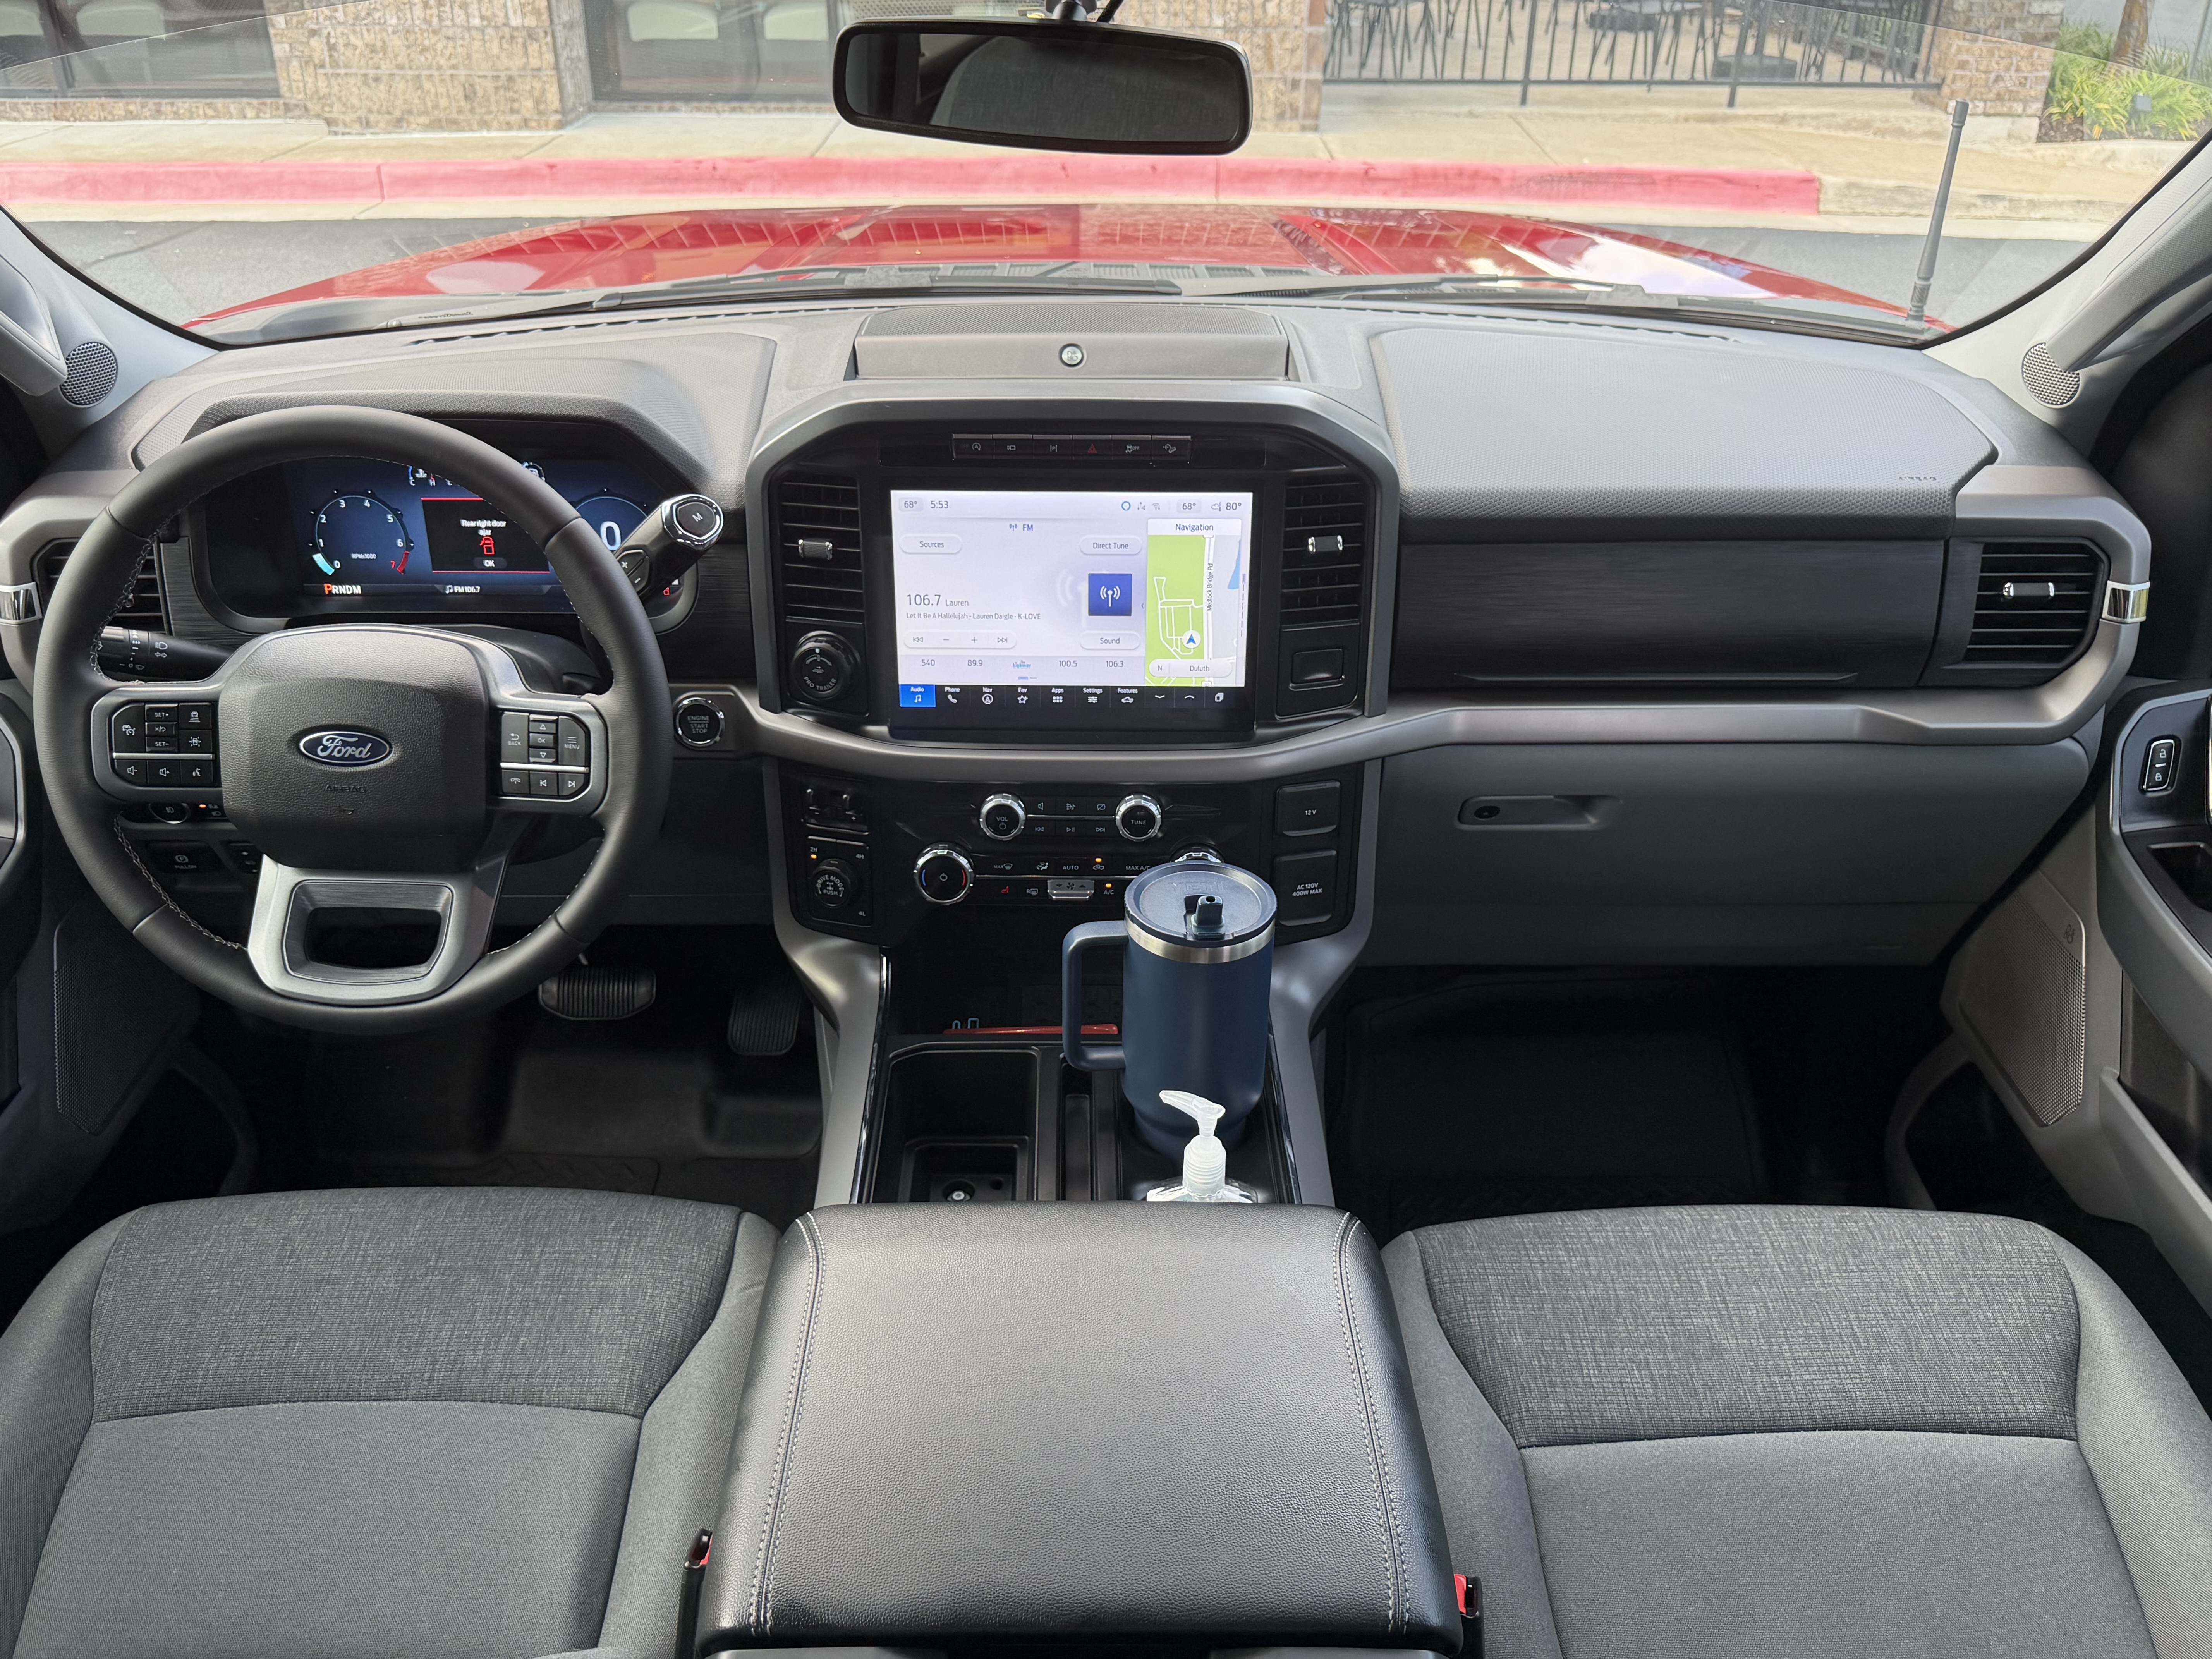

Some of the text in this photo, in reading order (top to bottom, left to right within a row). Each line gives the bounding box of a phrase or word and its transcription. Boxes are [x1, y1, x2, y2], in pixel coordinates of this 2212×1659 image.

[339, 500, 345, 508] 3
[364, 500, 370, 508] 4
[931, 501, 948, 509] 5:53
[1226, 503, 1242, 511] 80°
[320, 515, 327, 523] 2
[387, 514, 394, 523] 5
[692, 512, 703, 522] M
[1175, 523, 1214, 532] Navigation
[600, 521, 621, 551] 0
[318, 539, 324, 547] 1
[396, 539, 403, 547] 6
[333, 560, 341, 568] 0
[390, 560, 396, 568] 7
[907, 594, 941, 606] 106.7
[804, 677, 837, 691] PRO TRAILER
[317, 735, 372, 758] Ford
[816, 874, 845, 891] DRIVE MODE
